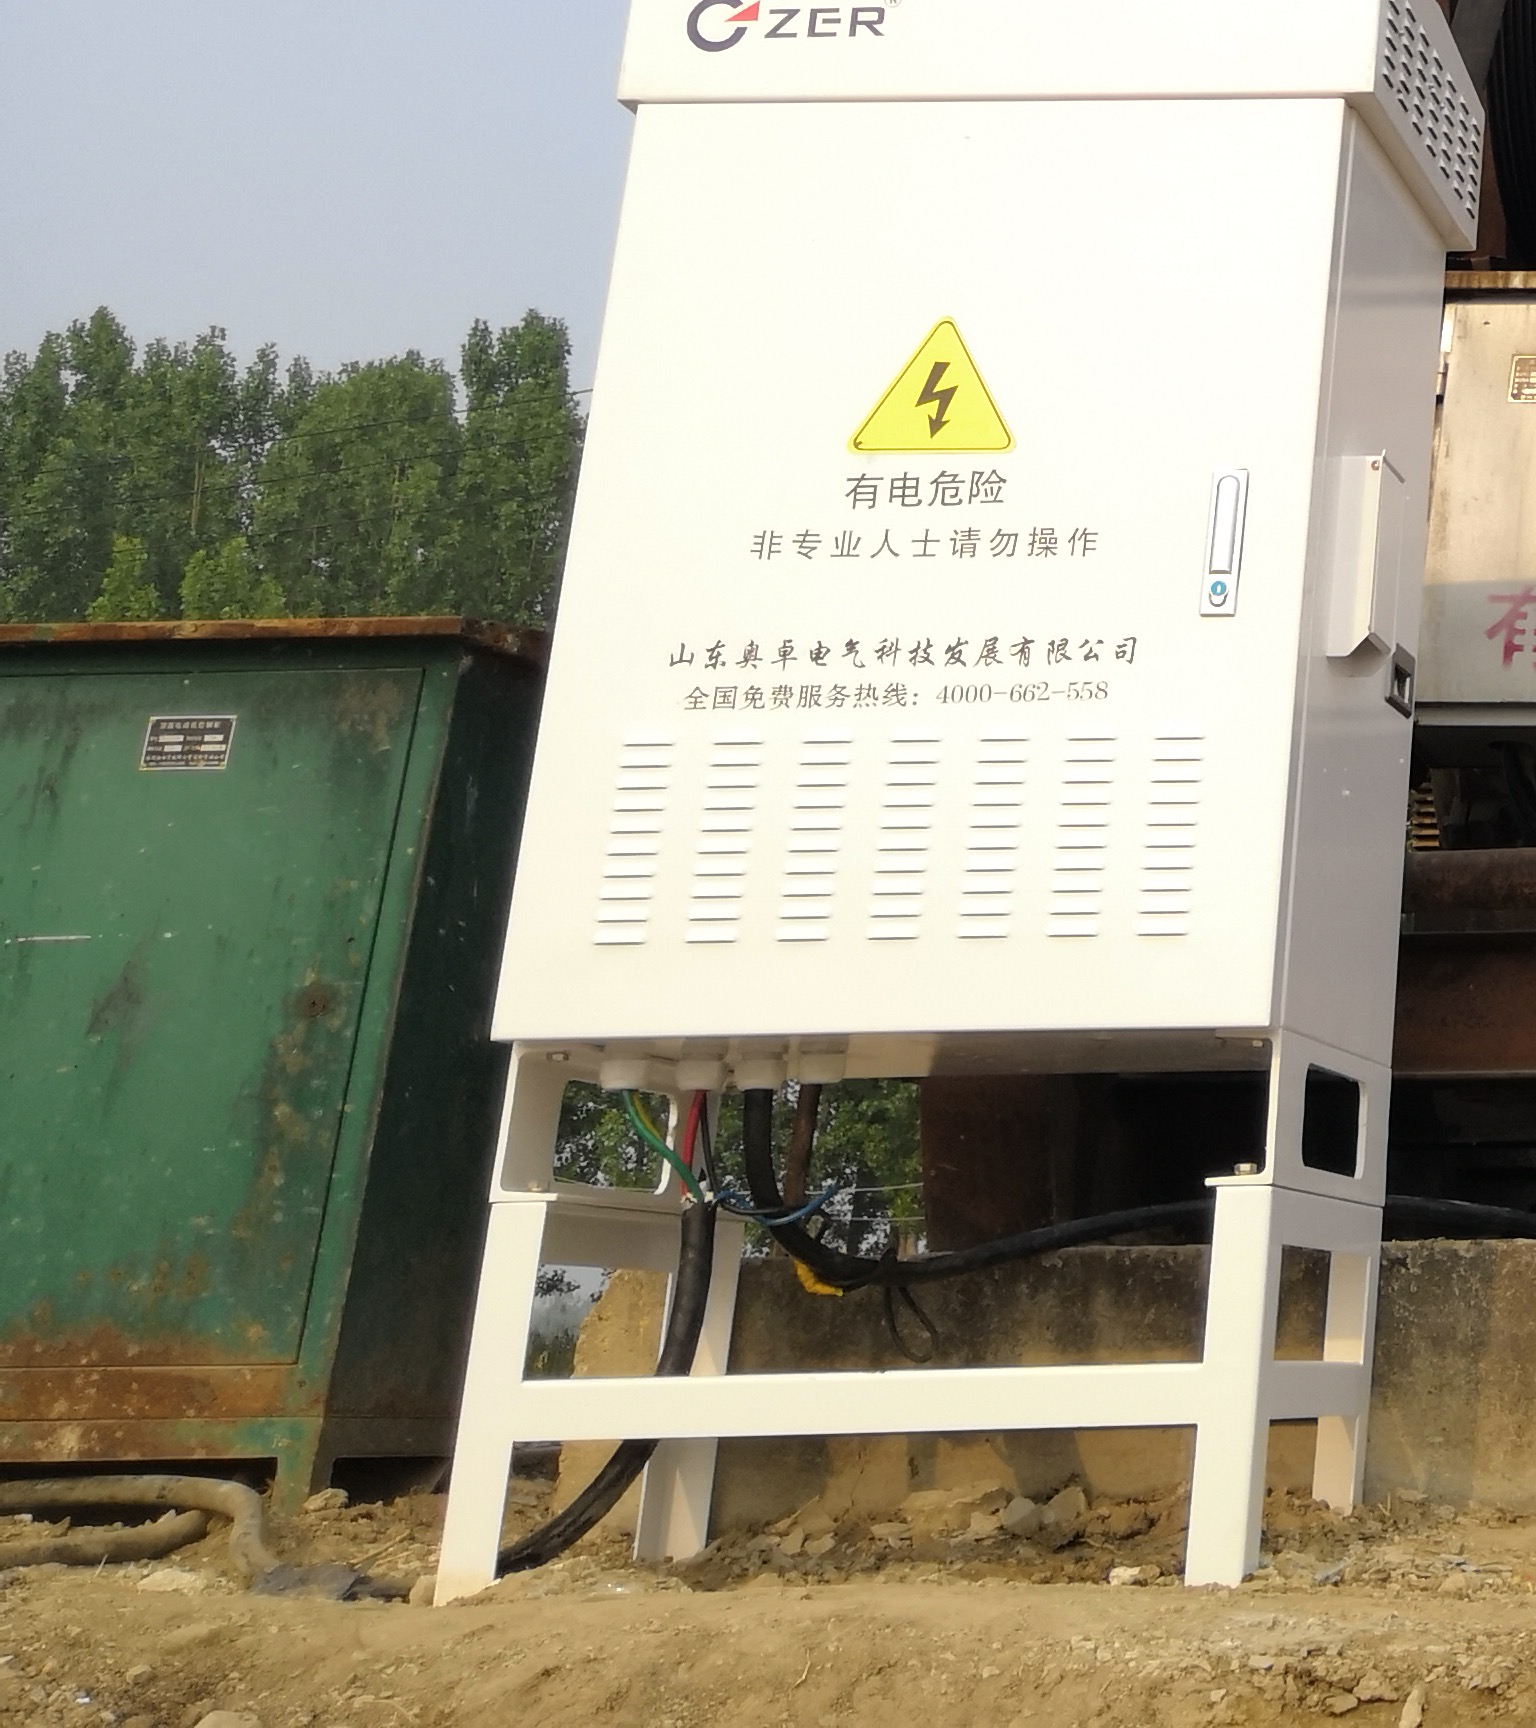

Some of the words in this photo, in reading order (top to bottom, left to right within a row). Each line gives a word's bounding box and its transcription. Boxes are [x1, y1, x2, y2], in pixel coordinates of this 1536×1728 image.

[844, 468, 1008, 511] 有电危险
[749, 525, 1100, 561] 非专业人士请勿操作
[668, 634, 1138, 672] 山东奥卓电气科技发展有限公司
